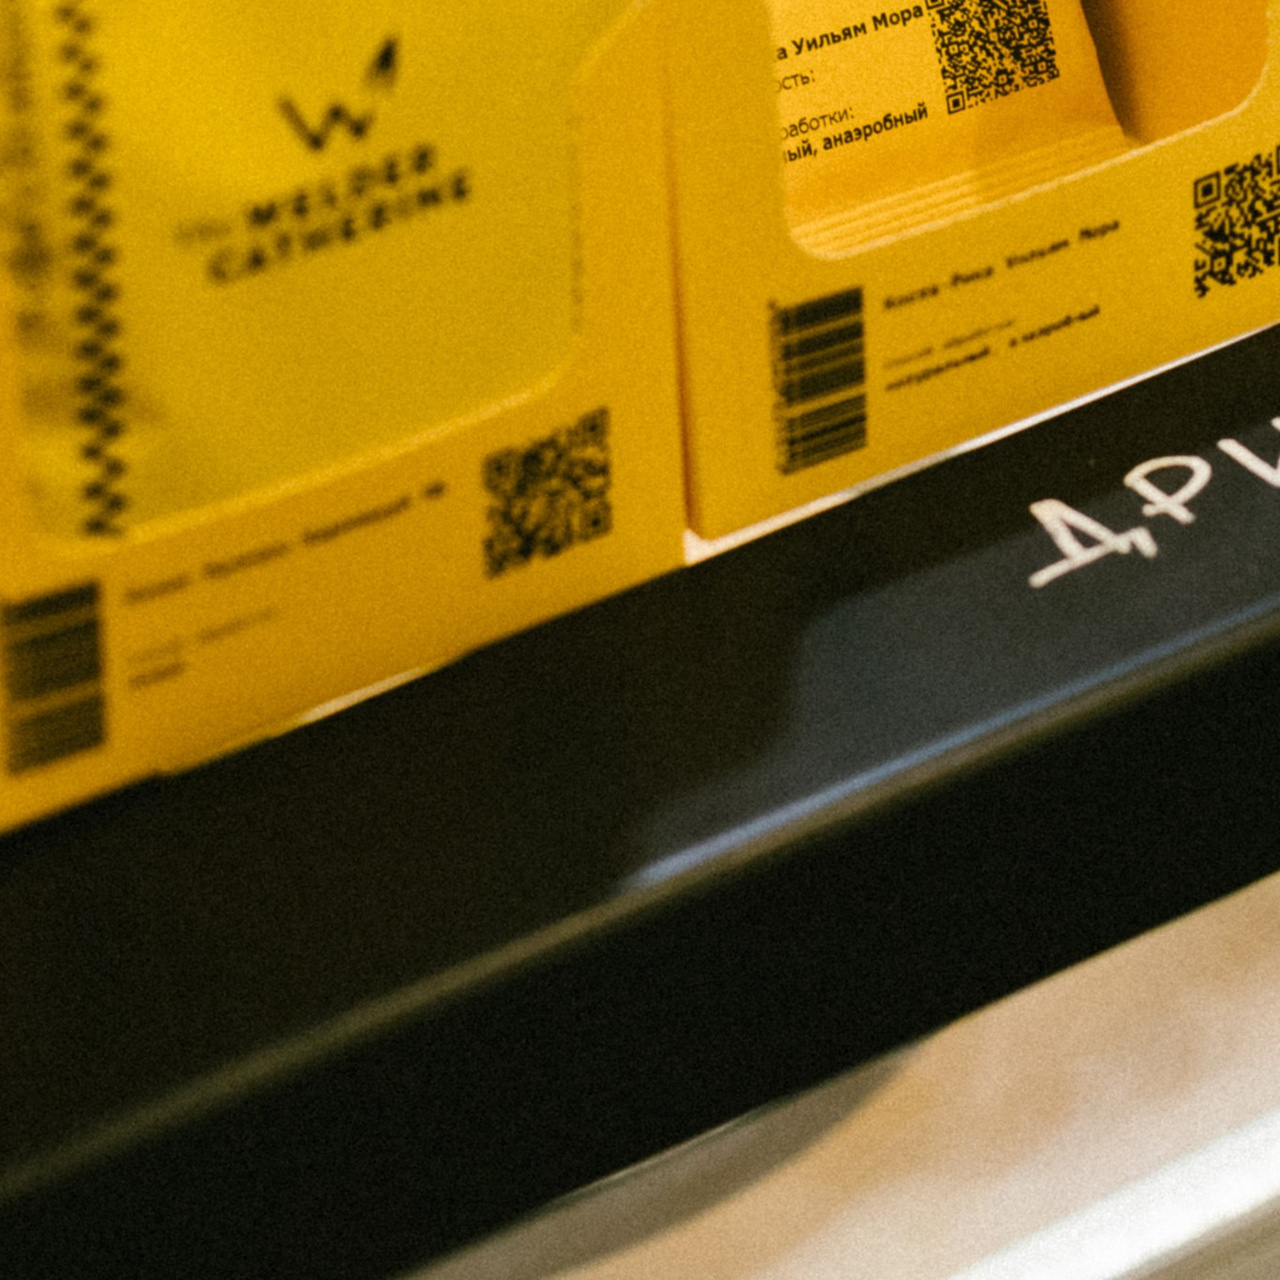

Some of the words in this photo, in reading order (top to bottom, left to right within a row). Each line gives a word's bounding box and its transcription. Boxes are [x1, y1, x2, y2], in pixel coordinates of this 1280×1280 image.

[792, 22, 867, 55] Уильям
[872, 4, 924, 31] Мора
[822, 101, 929, 151] анаэробный
